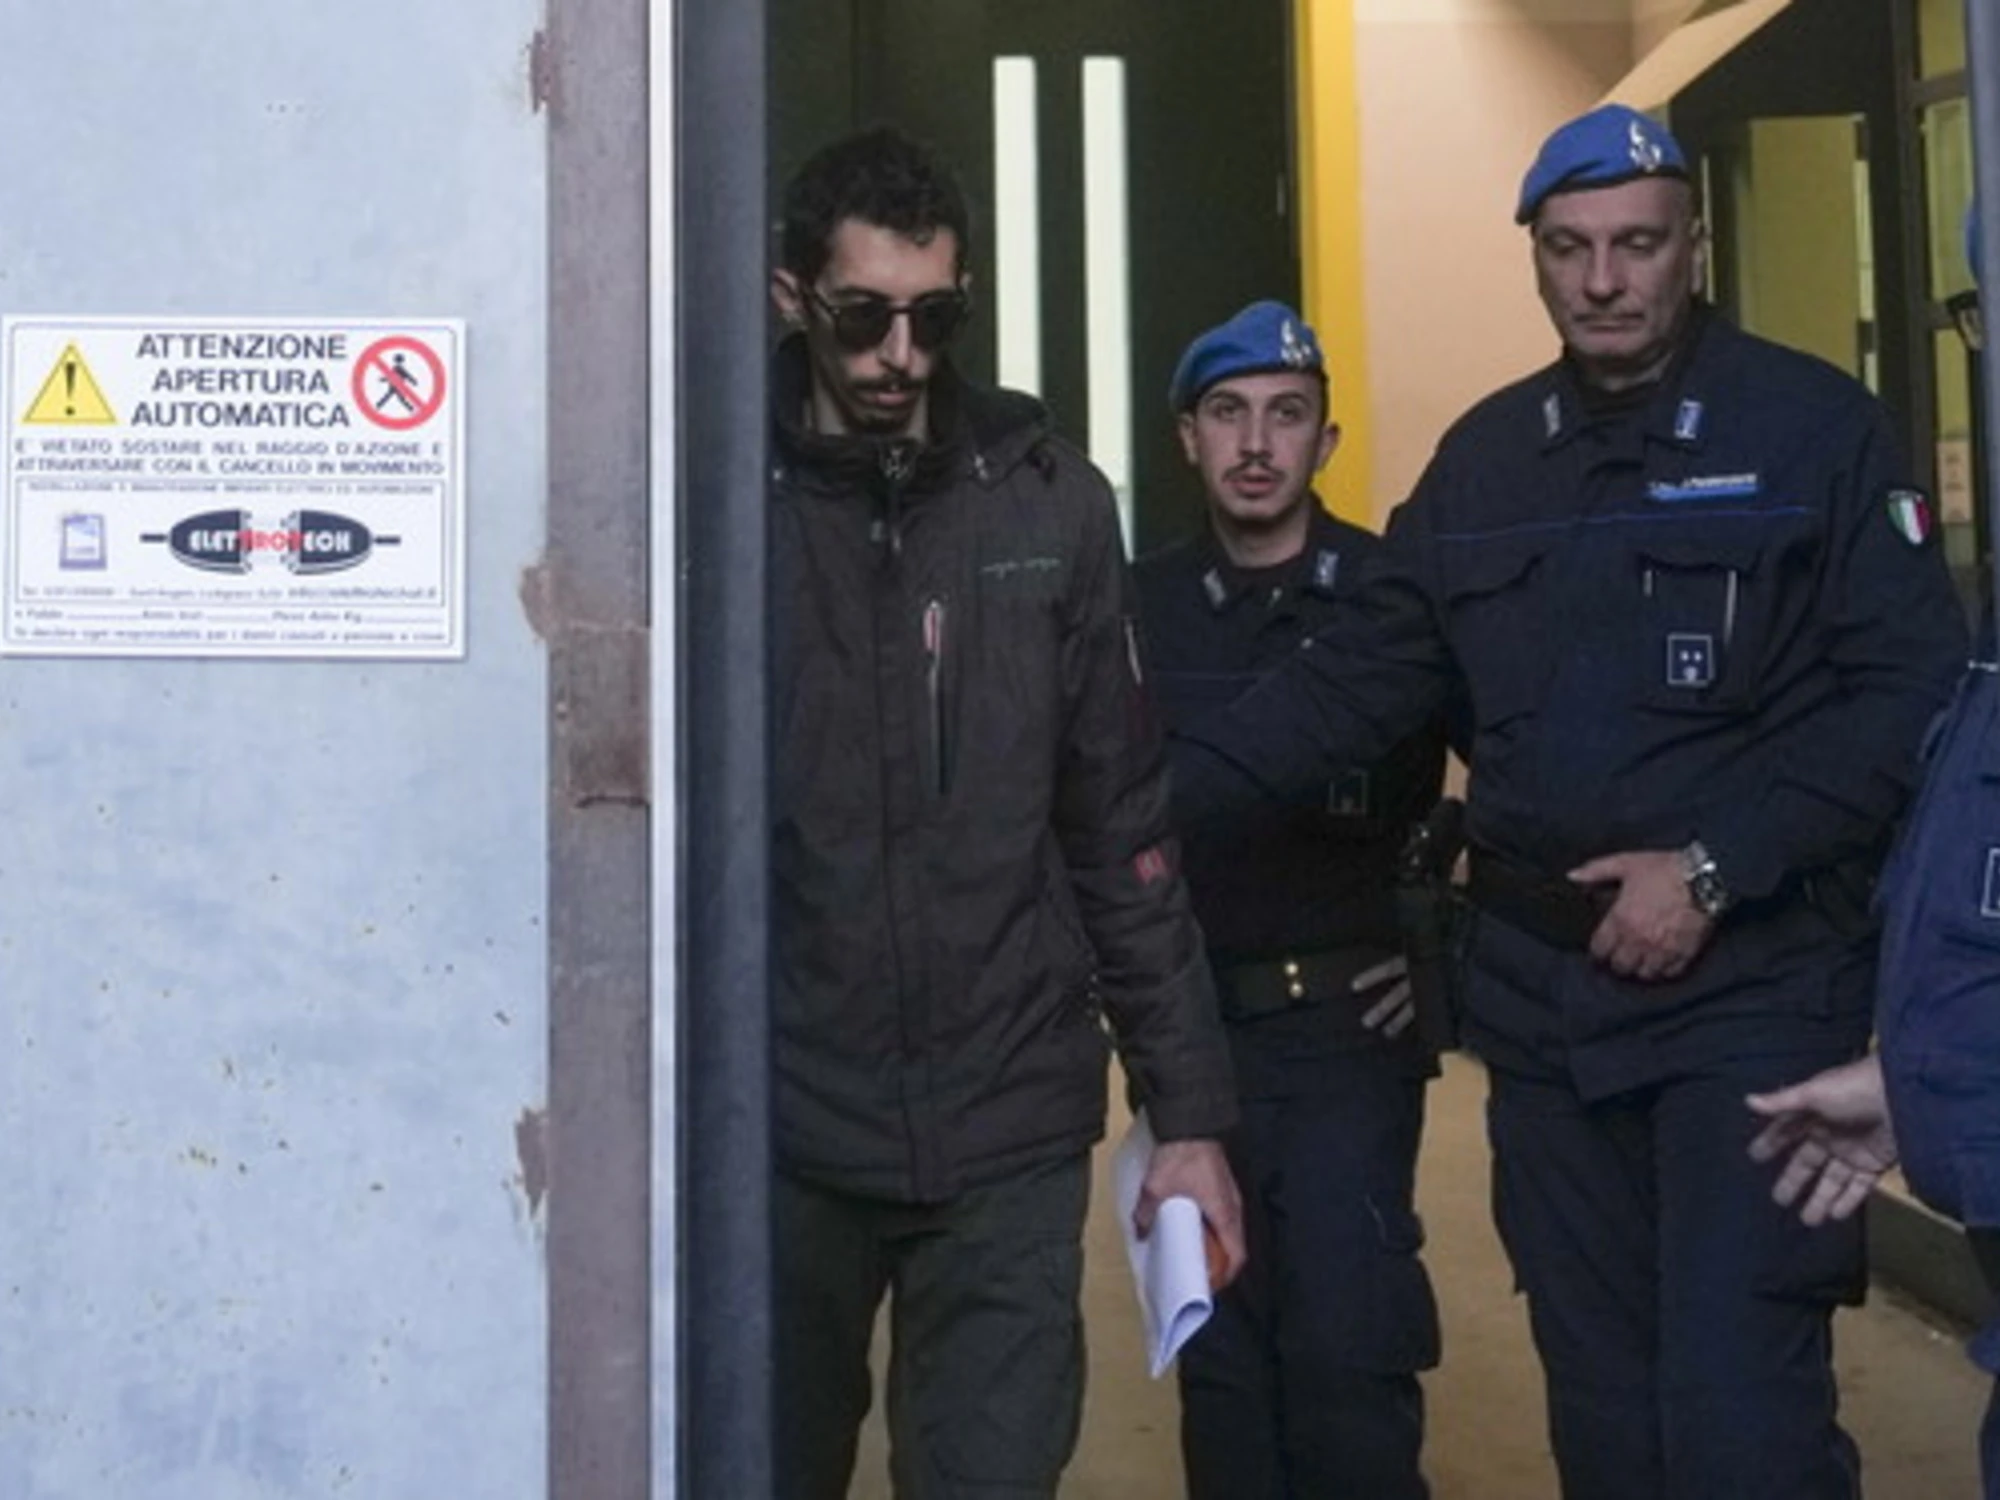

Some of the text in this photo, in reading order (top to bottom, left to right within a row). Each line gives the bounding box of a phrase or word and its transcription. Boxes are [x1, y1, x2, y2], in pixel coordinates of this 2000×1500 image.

[136, 333, 347, 359] ATTENZIONE
[152, 368, 329, 393] APERTURA
[131, 402, 350, 427] AUTOMATICA
[42, 438, 112, 455] VIETATO
[122, 439, 202, 455] SOSTARE
[213, 441, 247, 455] NEL
[256, 441, 329, 456] RAGGIO
[15, 457, 444, 476] ATTRAVERSARE CON IL CANCELLO IN MOVIMENTO
